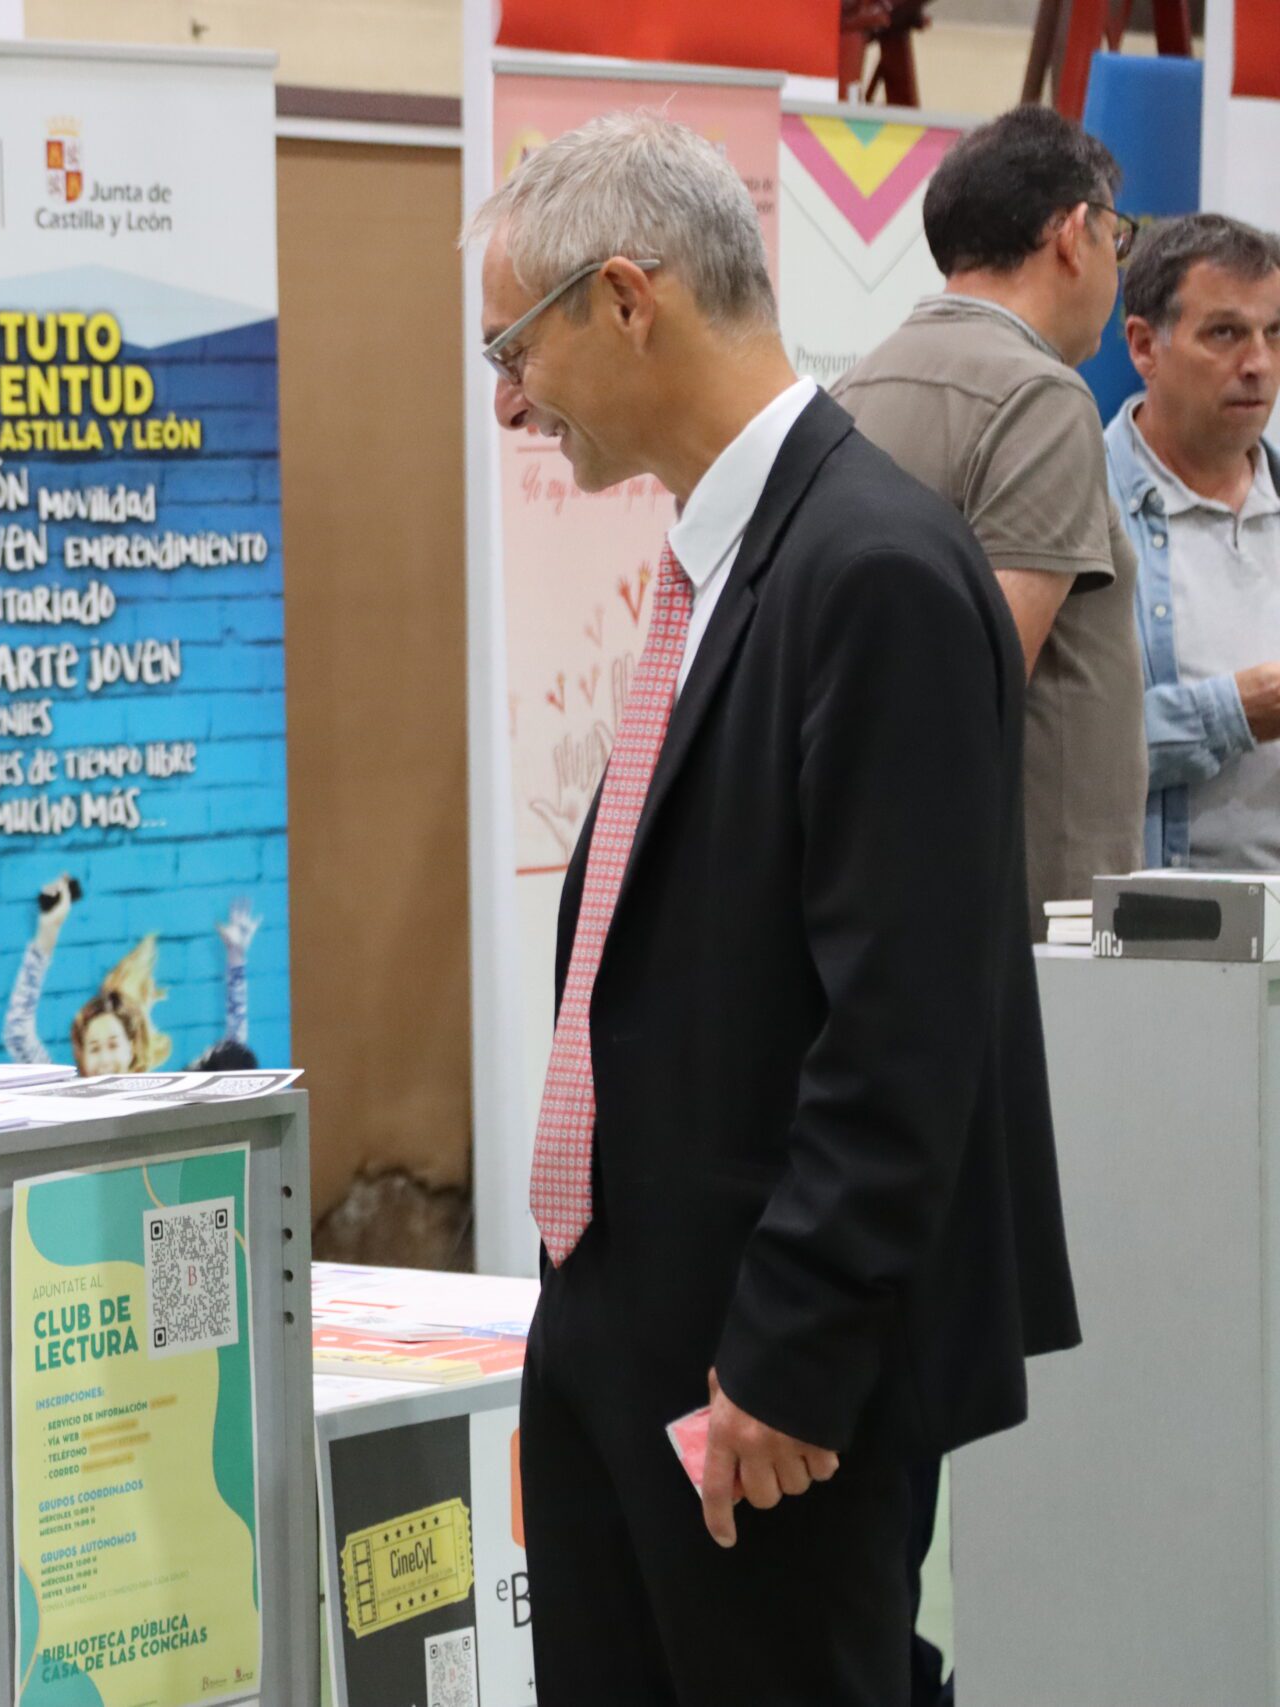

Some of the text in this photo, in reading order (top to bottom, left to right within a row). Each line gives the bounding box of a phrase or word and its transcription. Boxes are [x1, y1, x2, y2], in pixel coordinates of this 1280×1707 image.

[89, 182, 173, 204] Junta de
[35, 208, 173, 237] Castilla y León
[108, 420, 129, 450] Y
[131, 413, 202, 450] LEÓN
[32, 1273, 103, 1302] APÚNTATE AL
[188, 1265, 198, 1287] B
[34, 1294, 132, 1340] CLUB DE
[34, 1326, 139, 1372] LECTURA
[35, 1386, 105, 1411] INSCRIPCIONES:
[48, 1415, 82, 1431] SERVICIO
[83, 1413, 94, 1423] DE
[95, 1400, 148, 1421] INFORMACIÓN
[48, 1434, 61, 1447] VÍA
[62, 1431, 79, 1444] WEB
[48, 1446, 88, 1464] TELÉFONO
[48, 1464, 80, 1480] CORREO
[38, 1478, 144, 1513] GRUPOS COORDINADOS
[40, 1531, 137, 1565] GRUPOS AUTÓNOMOS
[389, 1536, 438, 1580] CineCyL
[41, 1626, 208, 1684] CASA DE LAS CONCHAS
[42, 1613, 189, 1666] BIBLIOTECA PÚBLICA
